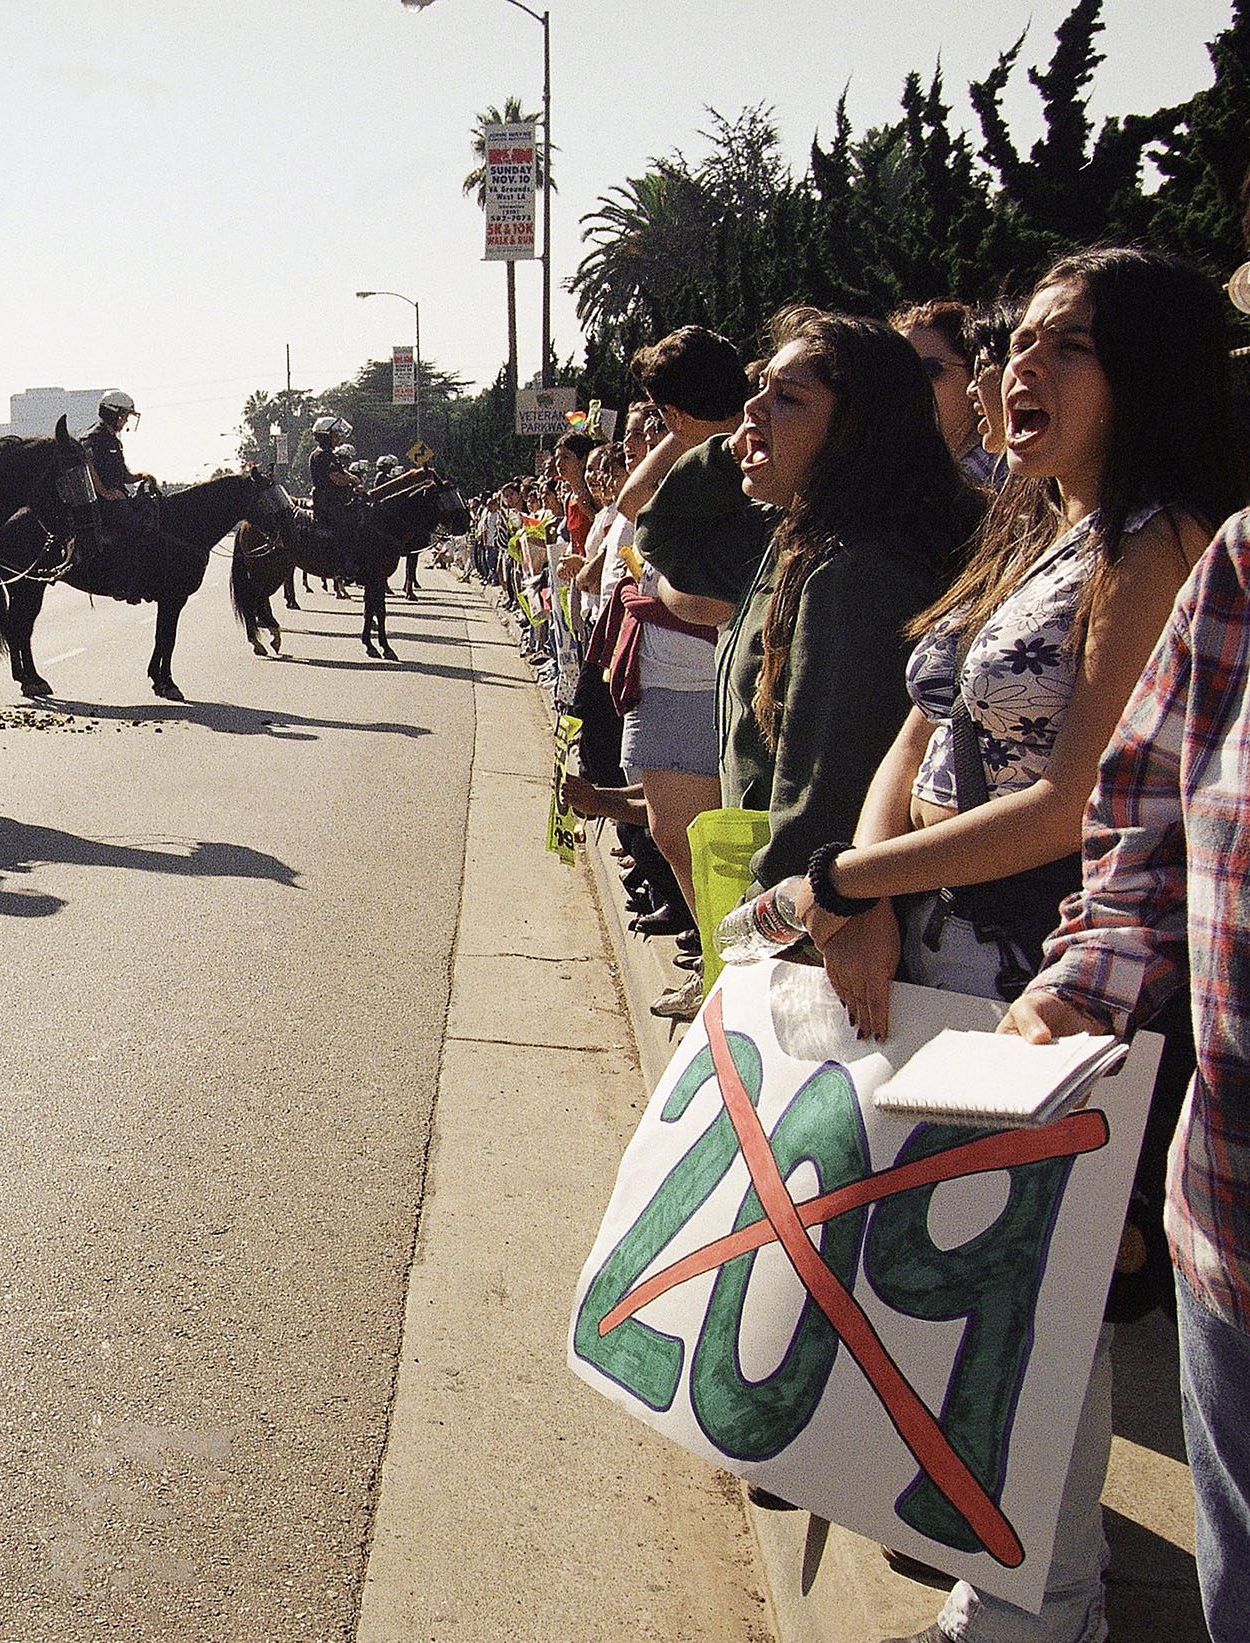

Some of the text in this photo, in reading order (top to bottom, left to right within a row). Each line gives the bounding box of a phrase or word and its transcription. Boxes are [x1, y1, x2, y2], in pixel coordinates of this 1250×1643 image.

[490, 165, 532, 175] SUNDAY
[492, 175, 530, 184] NOV. 10
[487, 223, 534, 234] 5K & 10K
[486, 236, 508, 245] WALK
[517, 236, 535, 244] RUN
[519, 410, 566, 421] VETERAN
[521, 422, 568, 433] PARKWAY
[574, 1030, 1079, 1554] 209
